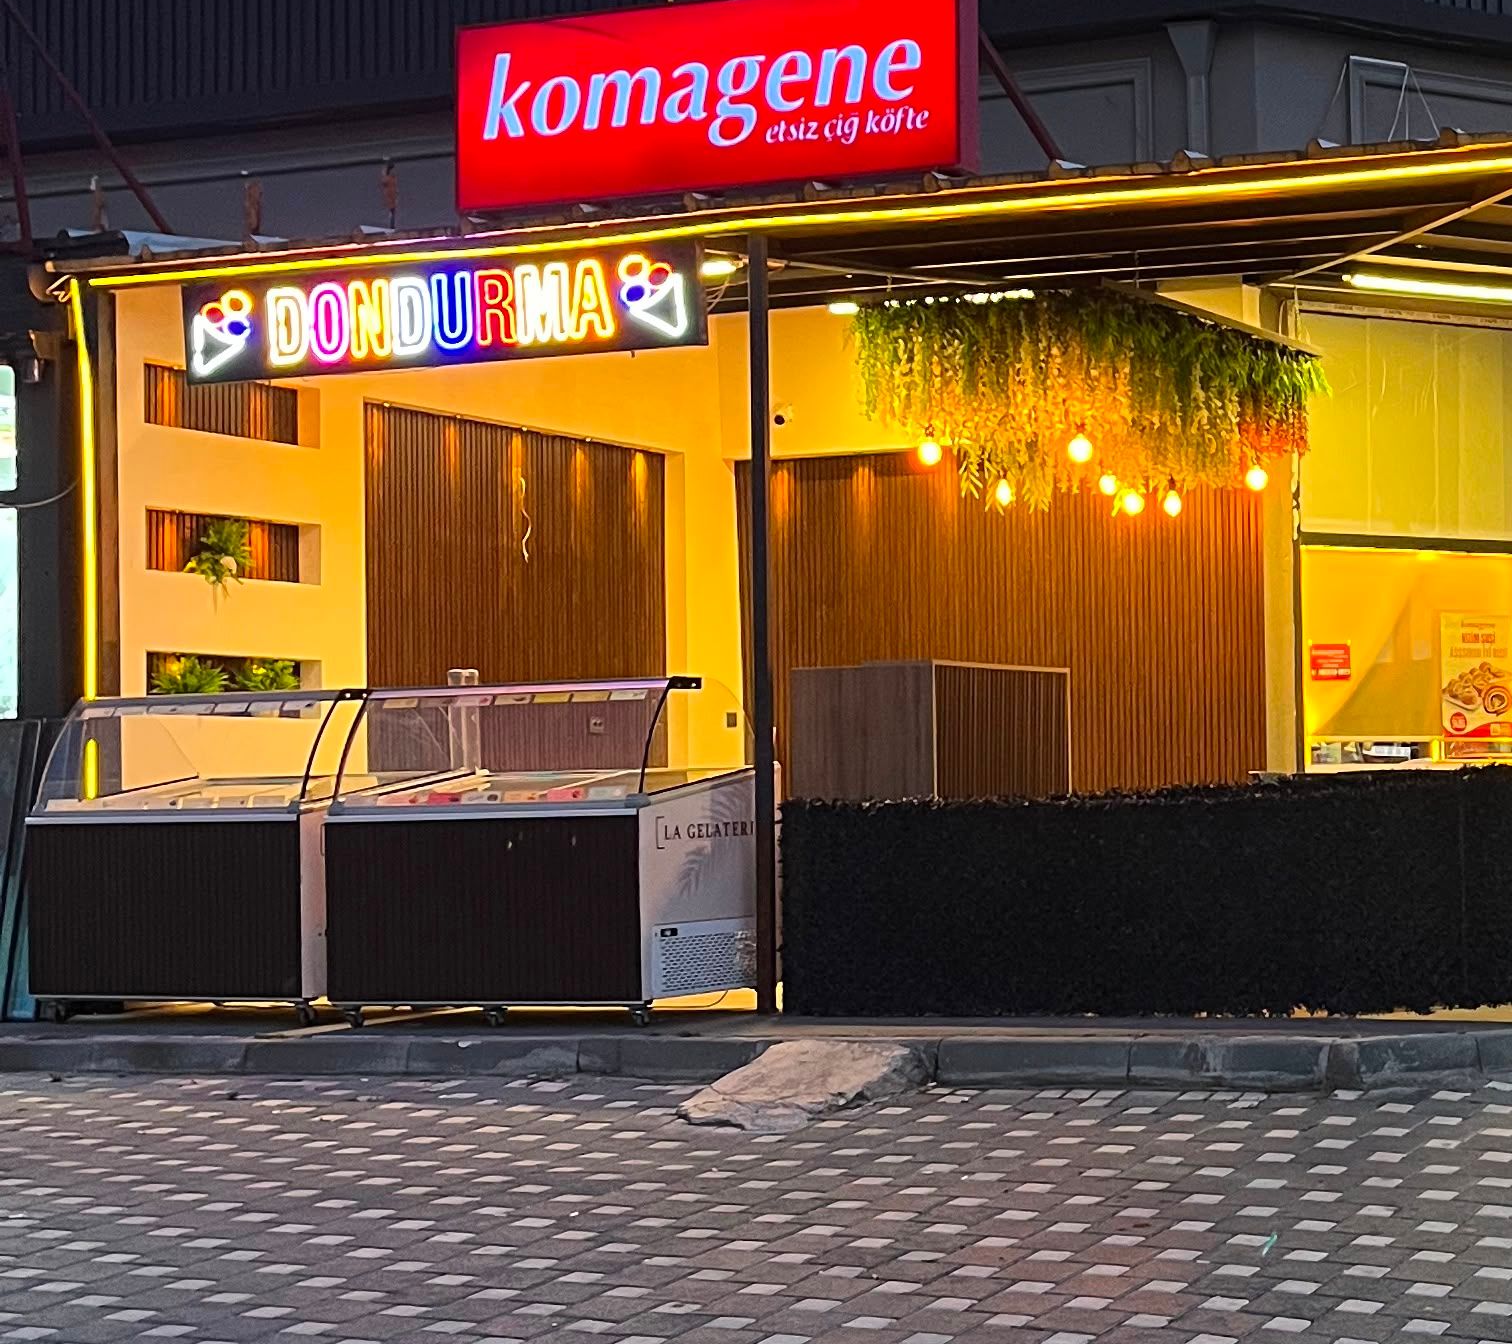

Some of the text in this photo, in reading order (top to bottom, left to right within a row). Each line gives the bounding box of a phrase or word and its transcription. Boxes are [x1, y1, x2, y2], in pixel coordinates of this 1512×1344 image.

[482, 38, 922, 147] komagene
[766, 105, 930, 144] etsiz çiğ köfte
[266, 259, 616, 367] DONDURMA
[664, 820, 755, 841] LA GELATERI
